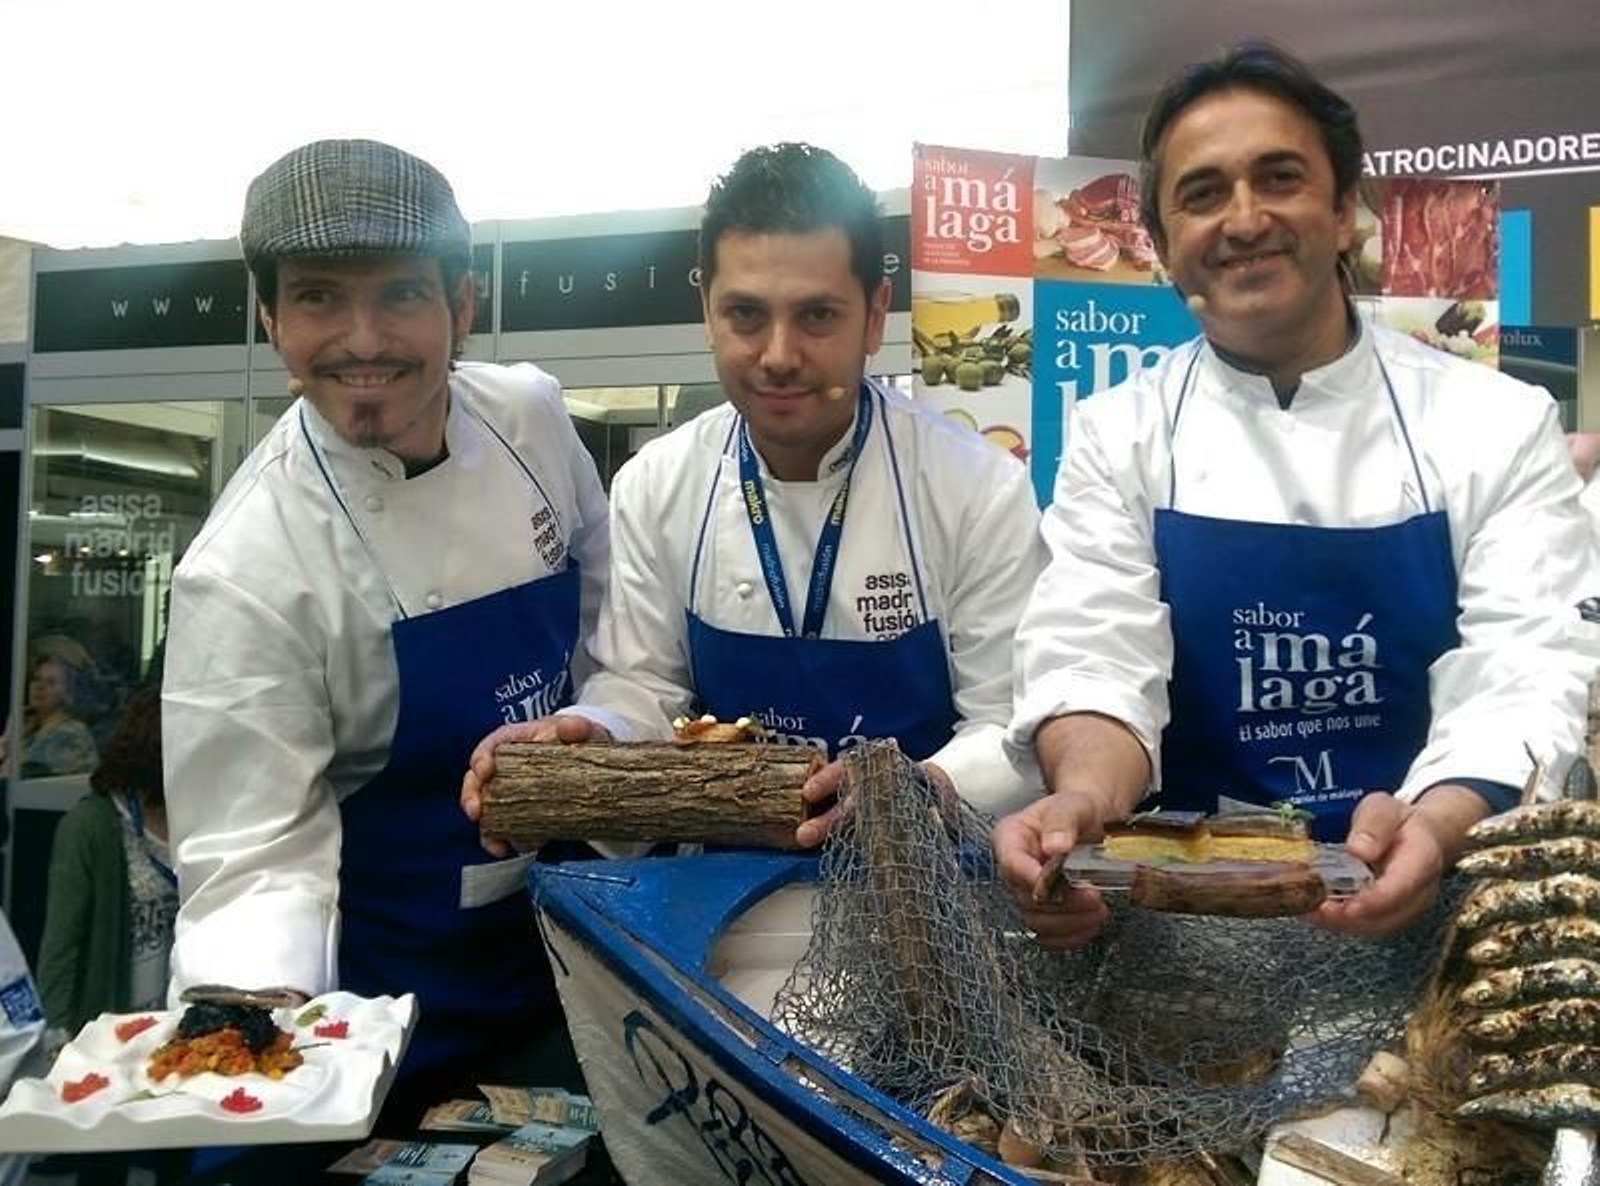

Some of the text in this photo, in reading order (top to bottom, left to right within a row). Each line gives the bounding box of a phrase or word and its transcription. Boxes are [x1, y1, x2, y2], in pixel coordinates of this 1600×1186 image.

[925, 195, 1021, 253] laga
[1055, 300, 1146, 334] sabor
[1055, 338, 1081, 370] a
[1502, 329, 1544, 348] olux
[80, 494, 161, 519] asisa
[64, 521, 176, 558] madrid
[71, 562, 148, 597] fusió
[1233, 602, 1304, 628] sabor
[1234, 613, 1384, 672] a má
[495, 668, 542, 703] sabor
[1236, 656, 1385, 715] laga
[759, 707, 808, 731] abor
[1255, 720, 1293, 741] sabor
[1297, 718, 1322, 739] que
